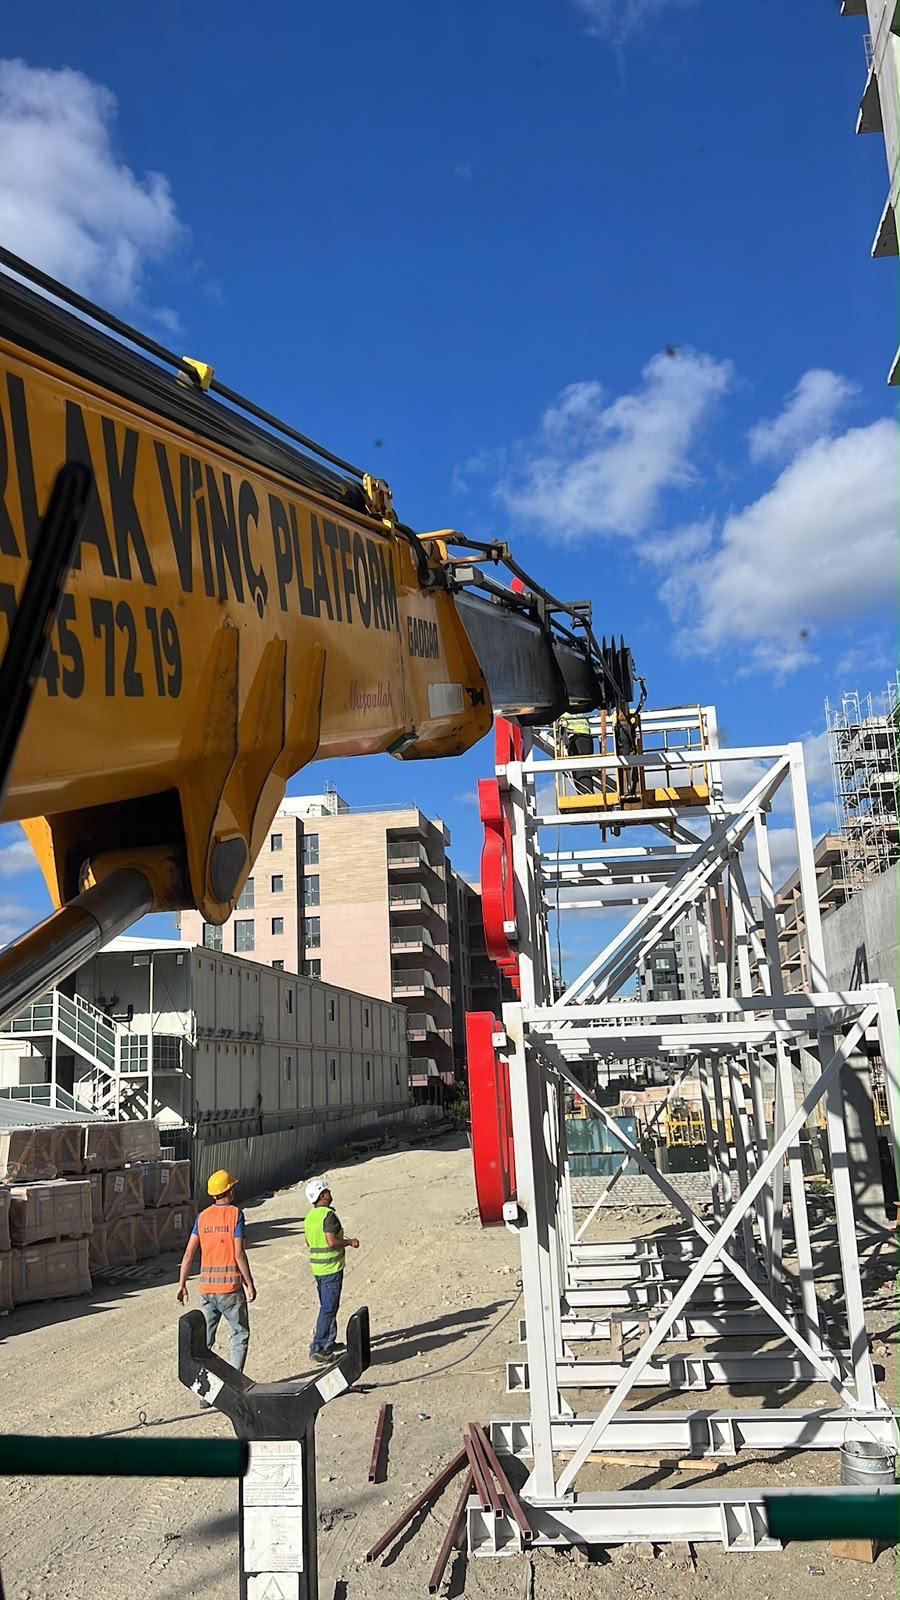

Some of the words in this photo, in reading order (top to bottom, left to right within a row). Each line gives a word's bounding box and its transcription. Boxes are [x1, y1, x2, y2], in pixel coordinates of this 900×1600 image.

[268, 493, 400, 633] PLATFORM
[90, 597, 145, 697] 72
[145, 606, 182, 699] 19
